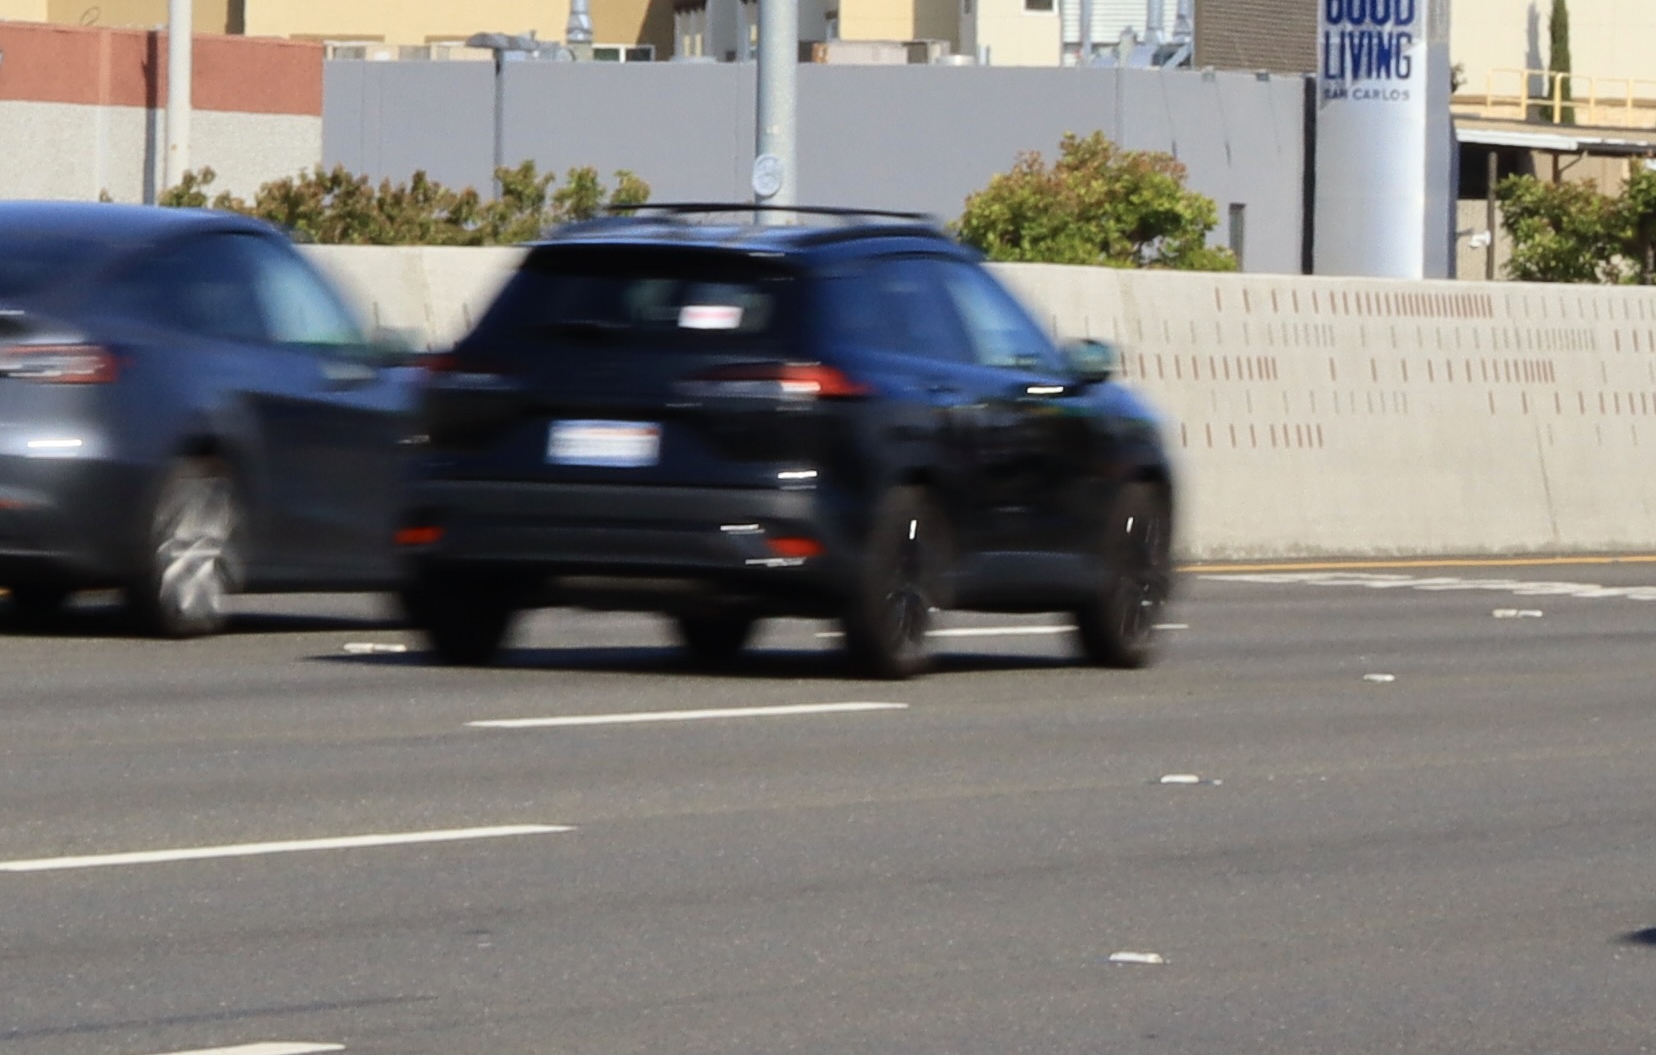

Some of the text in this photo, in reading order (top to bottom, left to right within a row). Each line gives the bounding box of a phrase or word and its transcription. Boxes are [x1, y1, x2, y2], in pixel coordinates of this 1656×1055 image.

[1324, 30, 1412, 81] LIVING
[1324, 88, 1410, 101] SAN CARLOS
